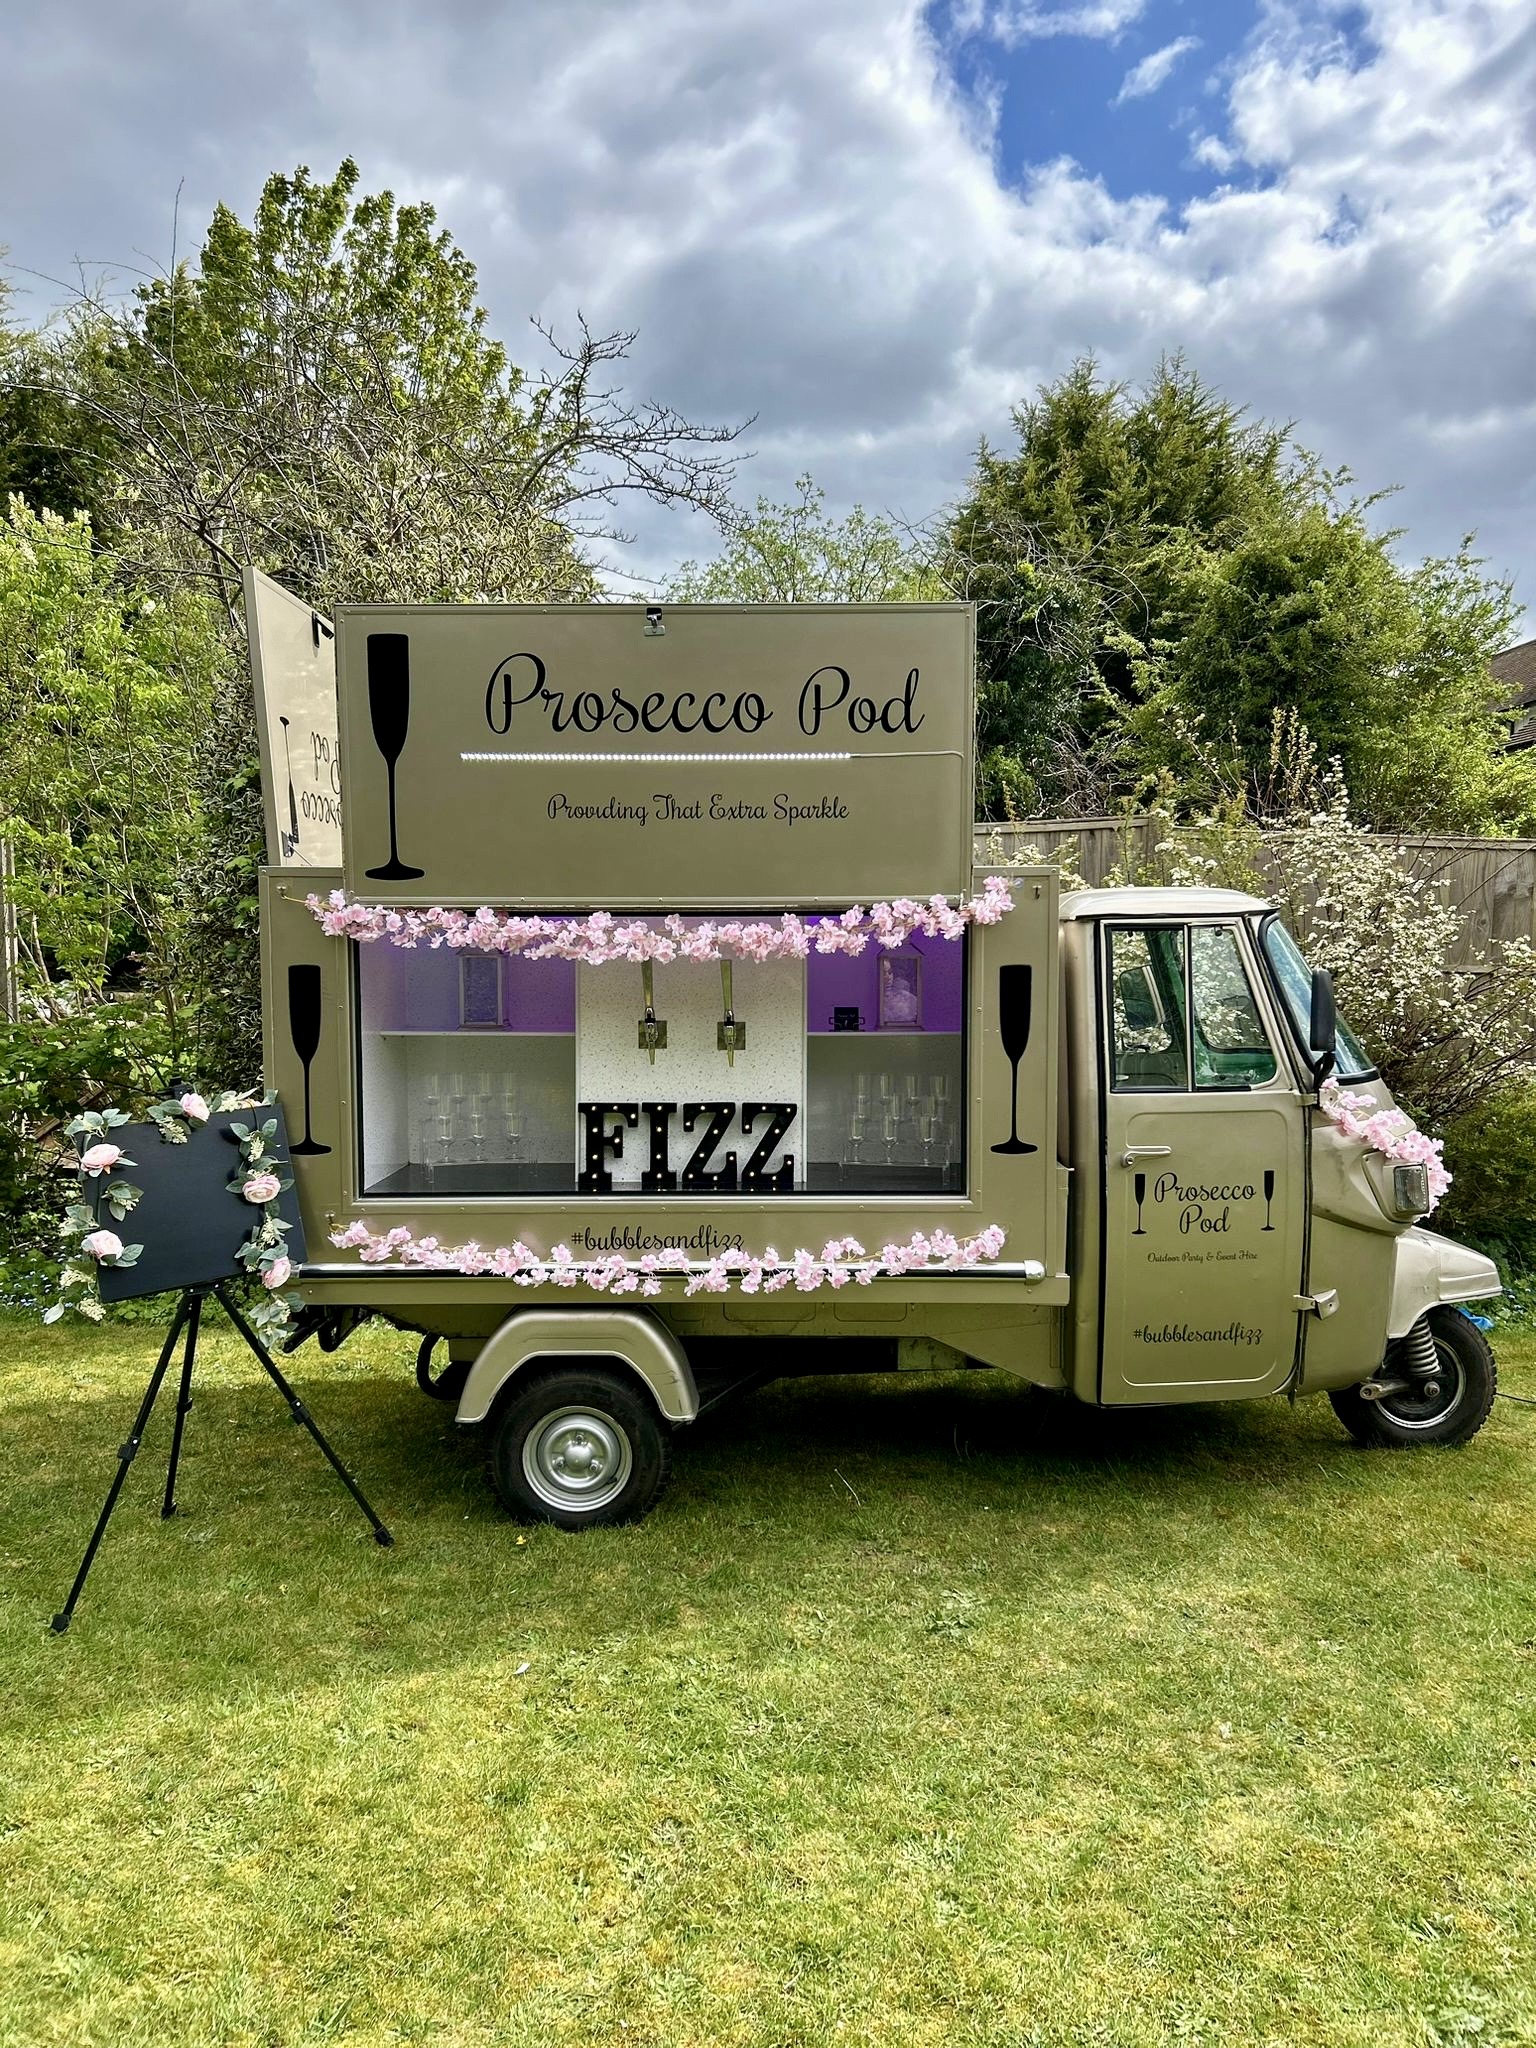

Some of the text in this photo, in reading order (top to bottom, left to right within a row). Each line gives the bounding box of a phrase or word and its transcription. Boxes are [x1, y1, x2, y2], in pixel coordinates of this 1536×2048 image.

[485, 652, 926, 736] Prosecco Pod
[547, 793, 850, 827] Providing That Extra Sparkle
[578, 1102, 798, 1190] FIZZ
[1154, 1172, 1257, 1203] Prosecco
[1179, 1203, 1231, 1235] Pod
[571, 1224, 745, 1255] #bubblesandfizz
[1147, 1249, 1259, 1264] Outdoor Party & Event Hire
[1133, 1321, 1264, 1347] #bubblesandfizz
